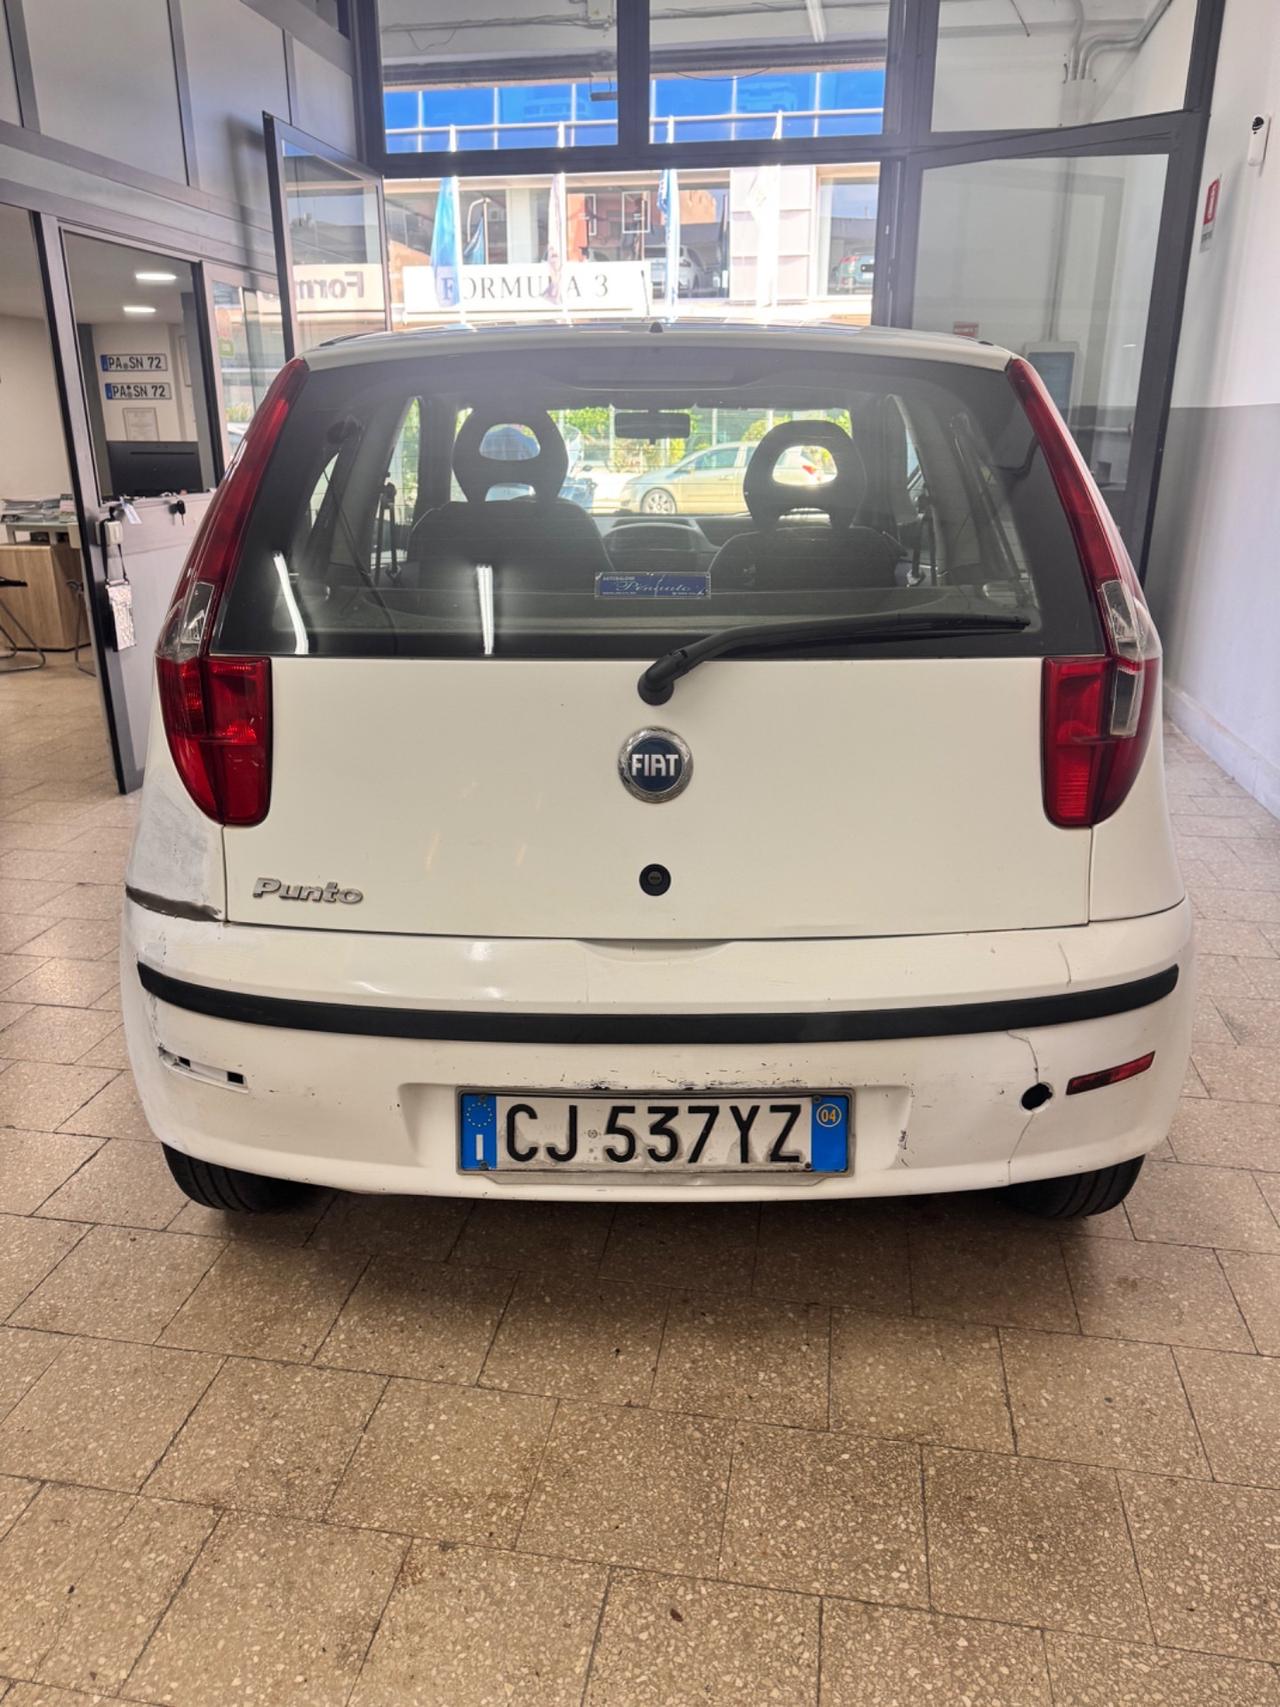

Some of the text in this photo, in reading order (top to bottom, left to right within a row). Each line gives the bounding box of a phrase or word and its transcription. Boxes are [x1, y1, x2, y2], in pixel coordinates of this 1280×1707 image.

[441, 274, 609, 300] FORMUA 3
[108, 356, 162, 369] PA SN 72
[112, 384, 166, 398] PA SN 72
[631, 753, 679, 777] FIAT
[253, 877, 364, 905] Punto
[475, 1103, 836, 1164] I CJ 537YZ 04
